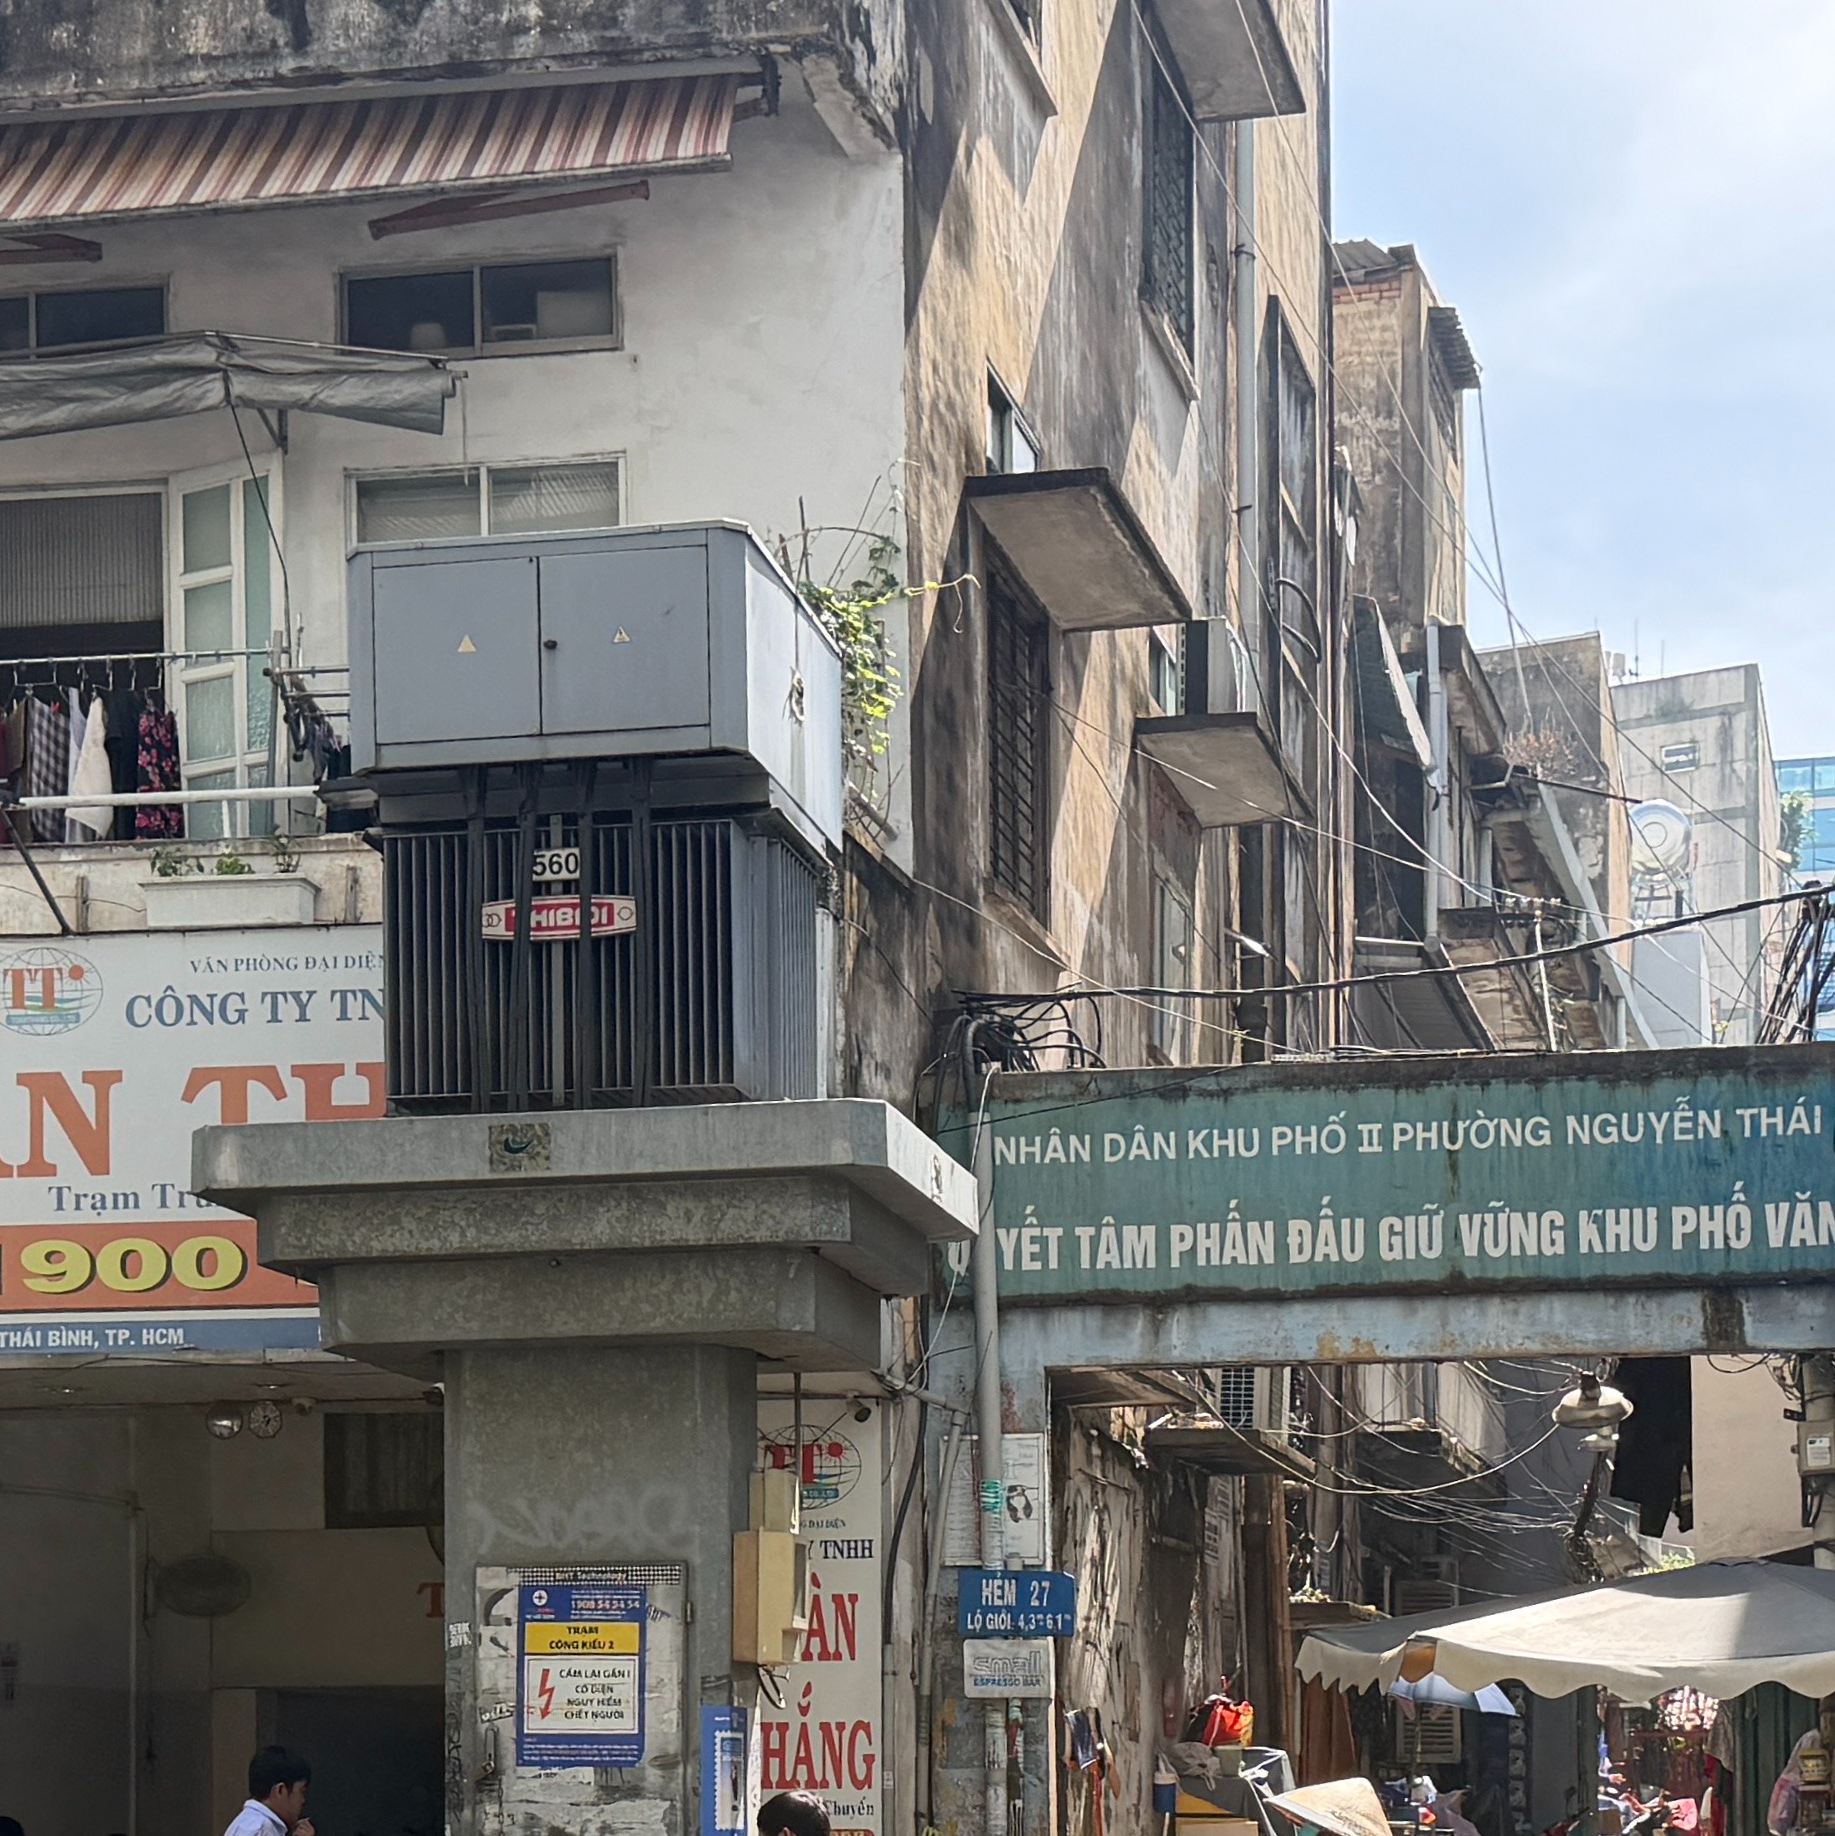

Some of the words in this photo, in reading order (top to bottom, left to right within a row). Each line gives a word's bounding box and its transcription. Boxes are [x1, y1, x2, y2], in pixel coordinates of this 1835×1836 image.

[534, 851, 579, 878] 560
[190, 954, 228, 974] VĂN
[234, 954, 299, 972] PHÒNG
[306, 955, 339, 973] ĐẠI
[125, 985, 249, 1028] CÔNG
[261, 990, 317, 1024] TY
[330, 988, 385, 1021] TN
[994, 1125, 1091, 1166] NHÂN
[1103, 1124, 1177, 1163] DÂN
[1188, 1127, 1260, 1159] KHU
[1271, 1110, 1348, 1156] PHỐ
[1393, 1110, 1552, 1153] PHƯỜNG
[1566, 1096, 1721, 1146] NGUYỄN
[1736, 1096, 1823, 1139] THÁI
[48, 1184, 141, 1215] Trạm
[1075, 1216, 1157, 1270] TÂM
[1170, 1198, 1275, 1268] PHẤN
[1288, 1195, 1365, 1264] ĐẤU
[1378, 1203, 1445, 1261] GIỮ
[1459, 1200, 1565, 1258] VỮNG
[1579, 1205, 1659, 1255] KHU
[1671, 1180, 1753, 1250] PHỐ
[47, 1325, 100, 1350] BÌNH,
[105, 1328, 135, 1346] TP.
[142, 1327, 185, 1346] HCM
[819, 1538, 874, 1560] TNHH
[981, 1571, 1017, 1607] HẺM
[1029, 1580, 1052, 1607] 27
[801, 1571, 859, 1662] ÀN
[973, 1651, 1043, 1675] small
[760, 1680, 877, 1791] HẮNG
